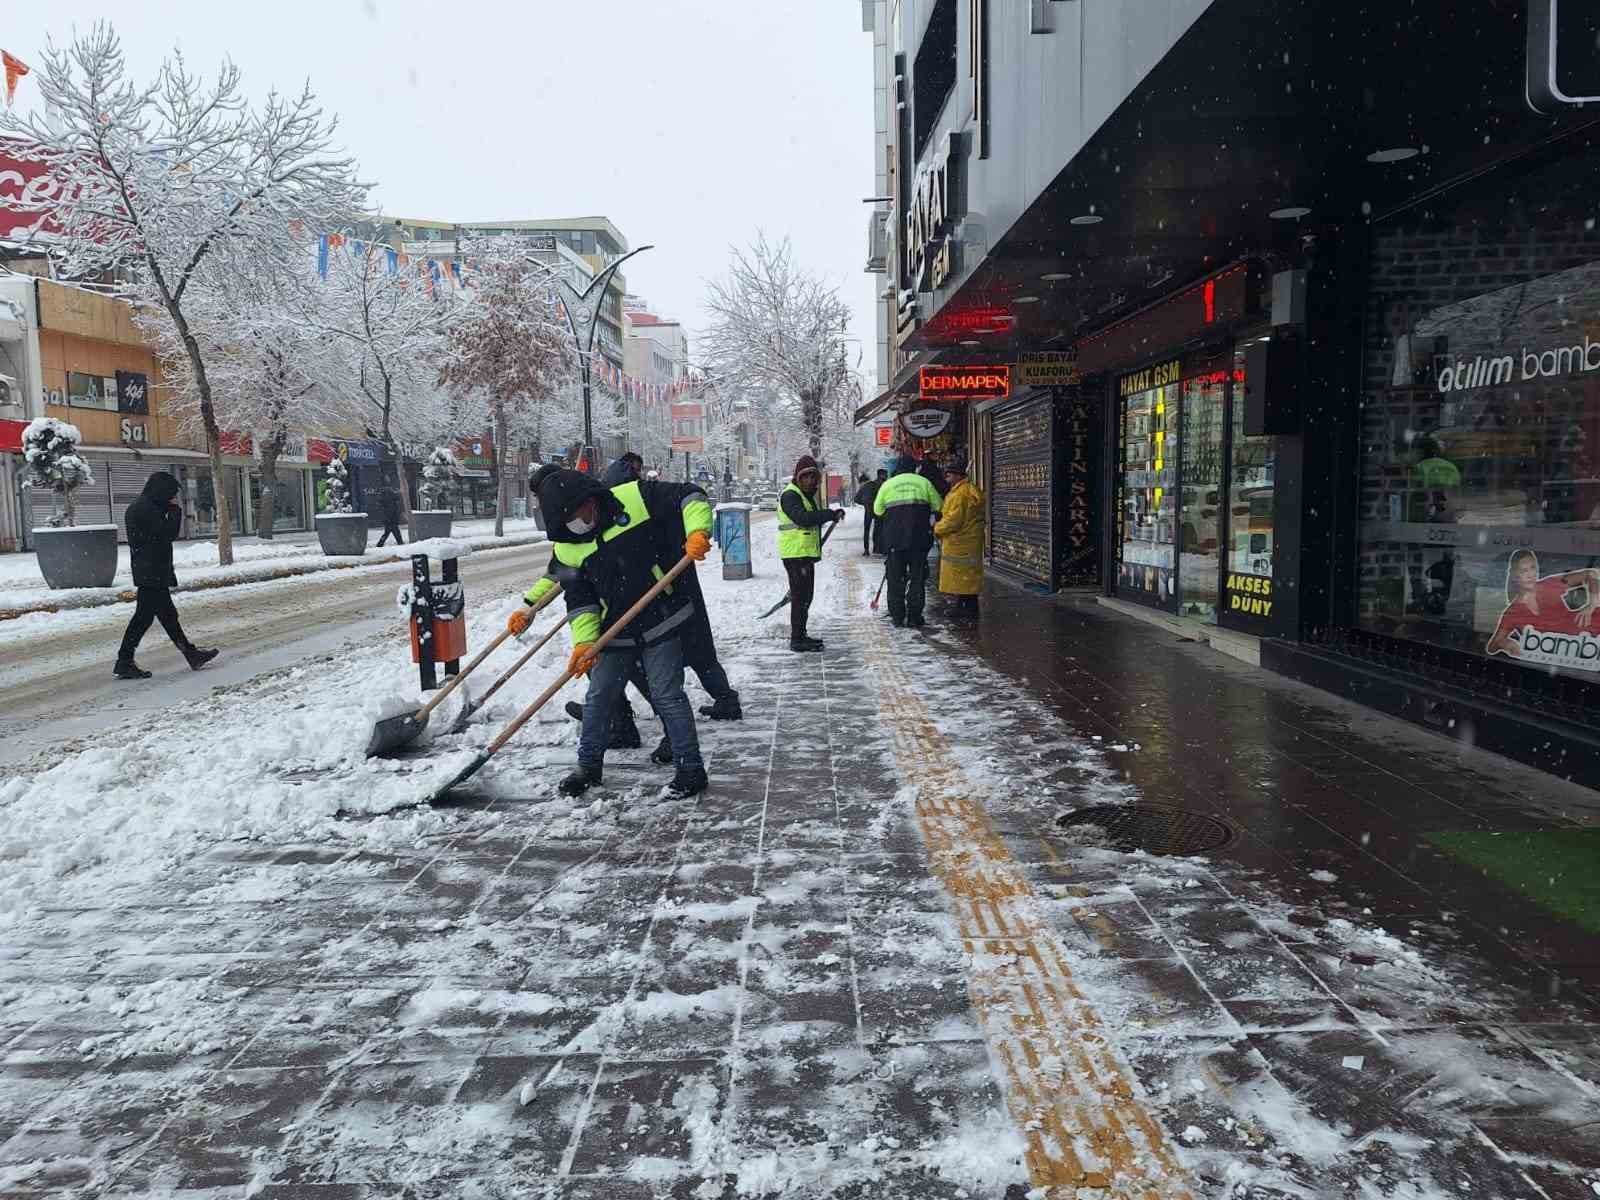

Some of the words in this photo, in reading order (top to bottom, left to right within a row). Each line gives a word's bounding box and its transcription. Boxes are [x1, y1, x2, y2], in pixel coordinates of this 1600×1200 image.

[921, 374, 1008, 391] DERMAPEN
[1120, 370, 1151, 396] HAYAT
[1154, 361, 1180, 386] GSM
[1226, 574, 1273, 595] AKSES
[1524, 628, 1600, 660] bamb
